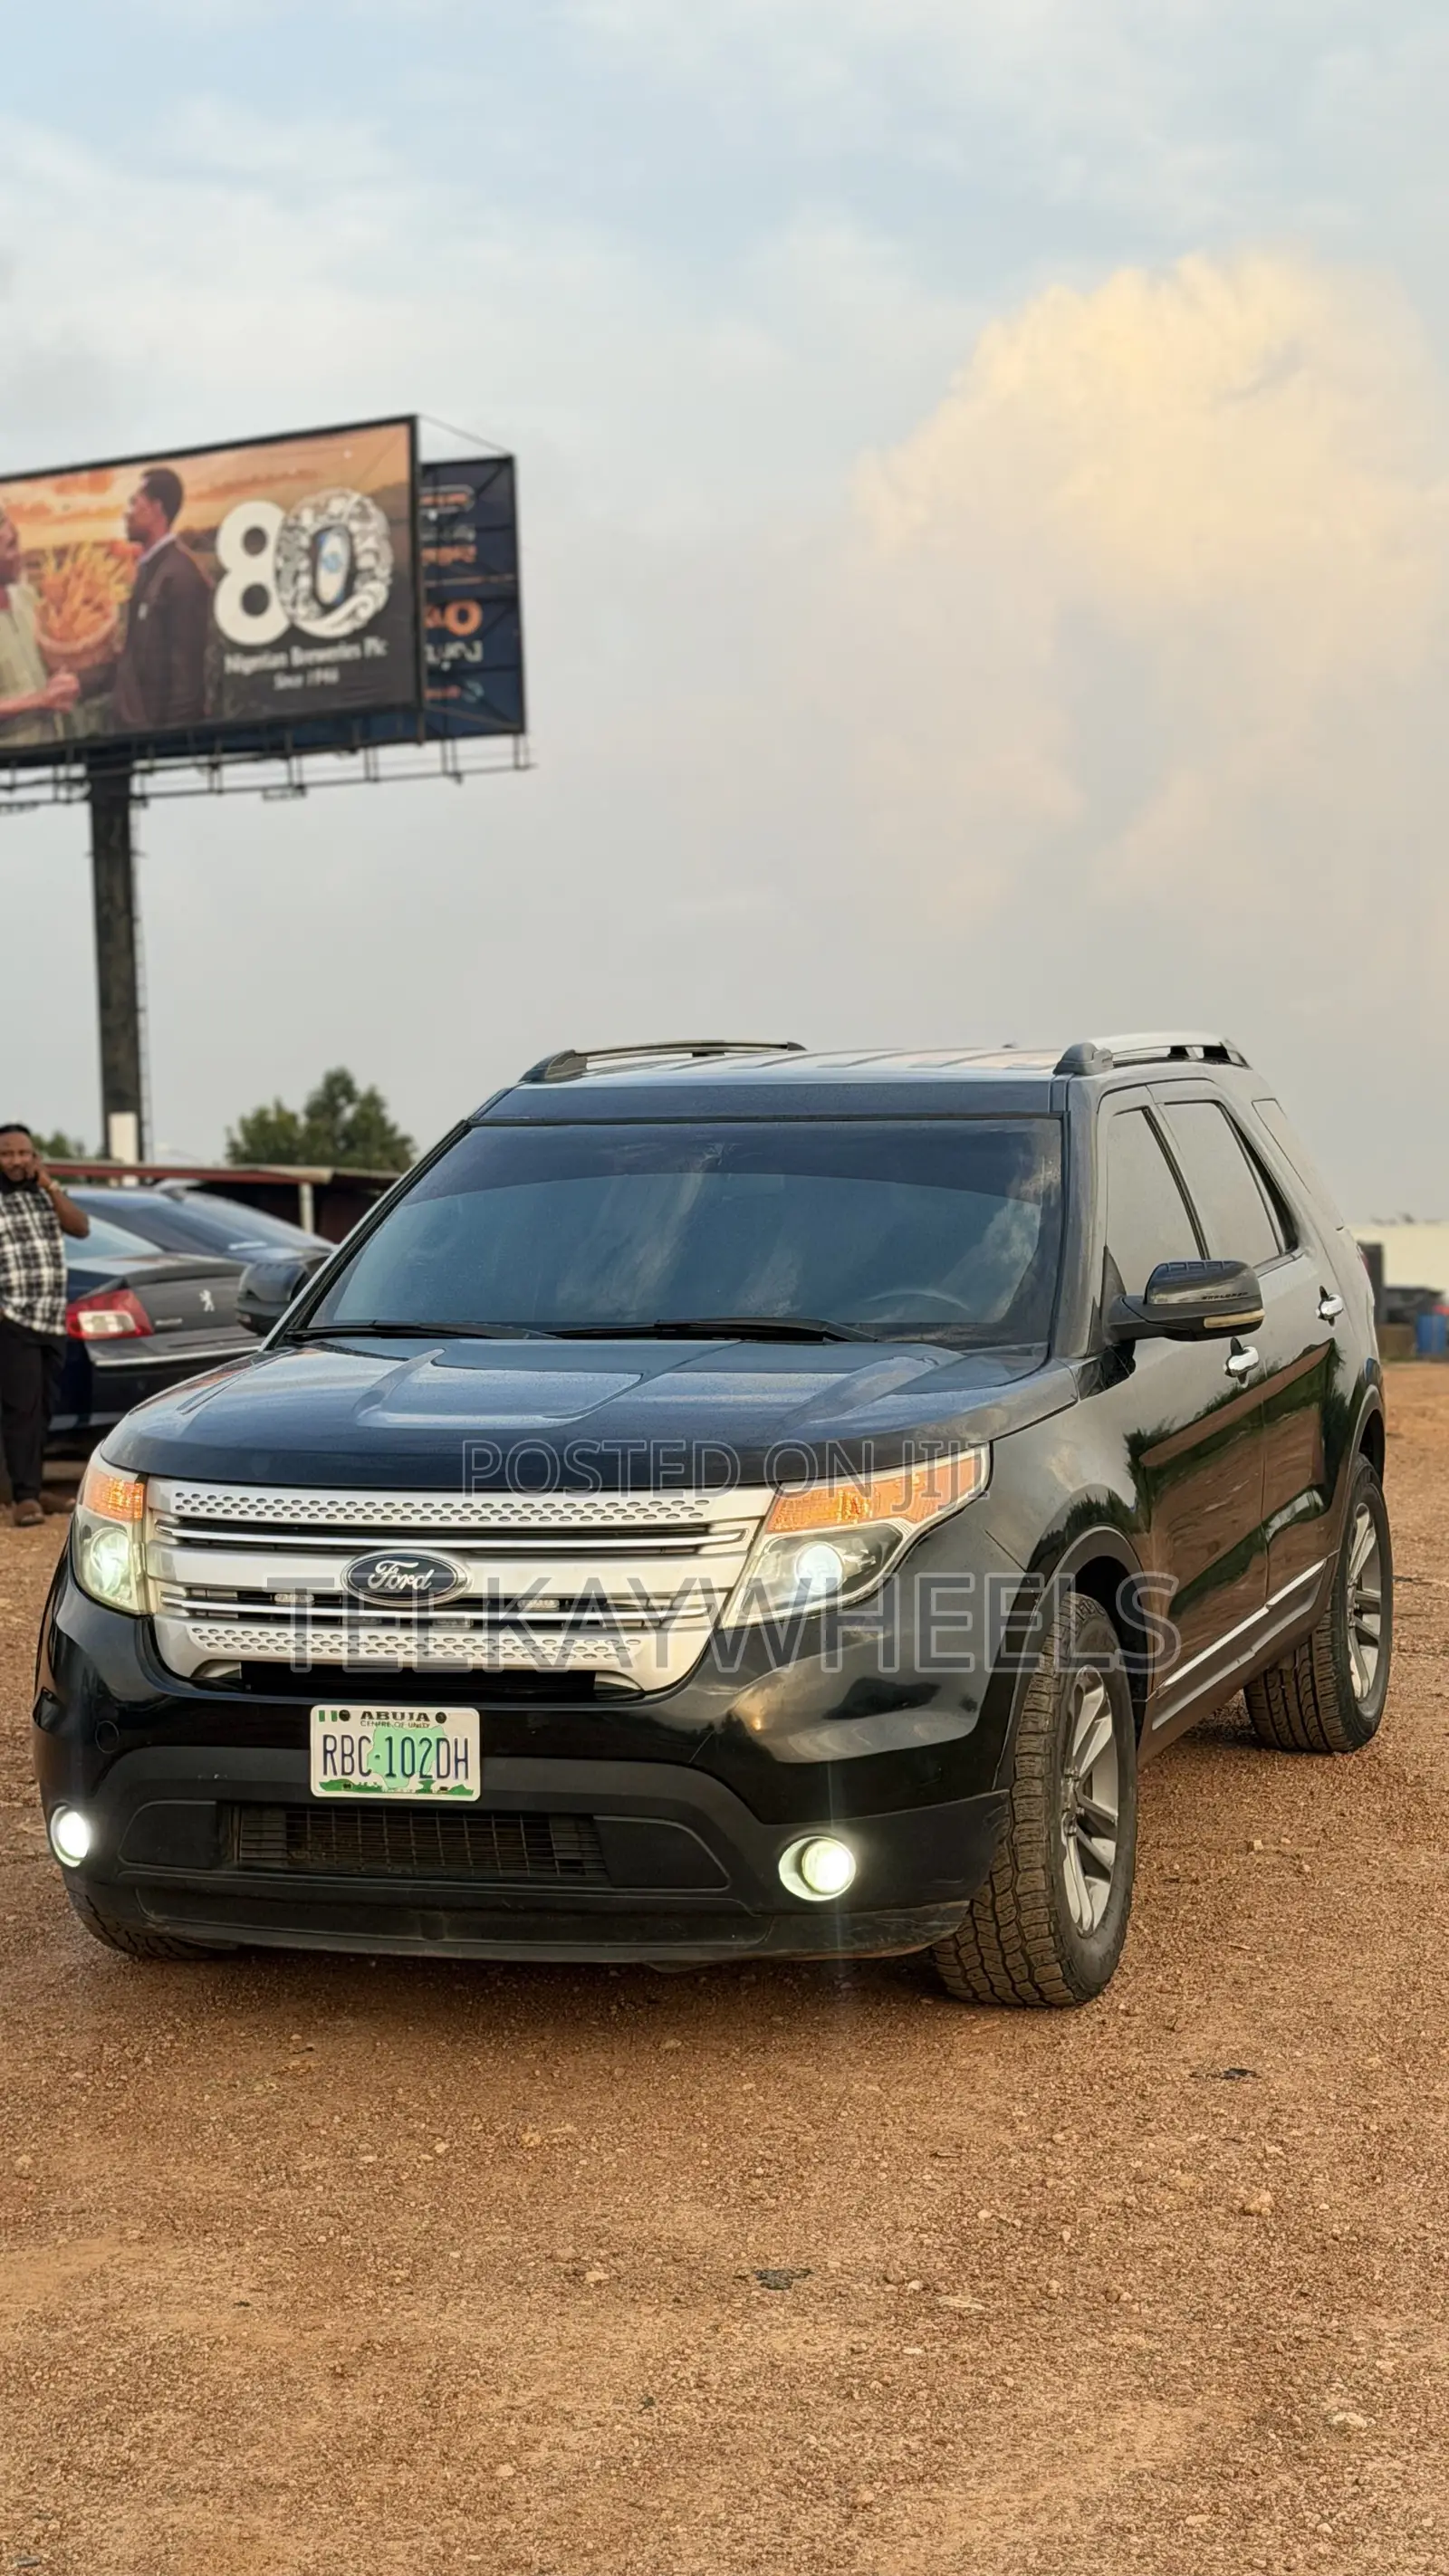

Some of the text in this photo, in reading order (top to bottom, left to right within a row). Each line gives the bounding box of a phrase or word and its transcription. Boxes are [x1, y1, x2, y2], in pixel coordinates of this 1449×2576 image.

[214, 486, 393, 646] 80
[367, 1559, 435, 1591] Ford
[360, 1710, 430, 1722] ABUJA
